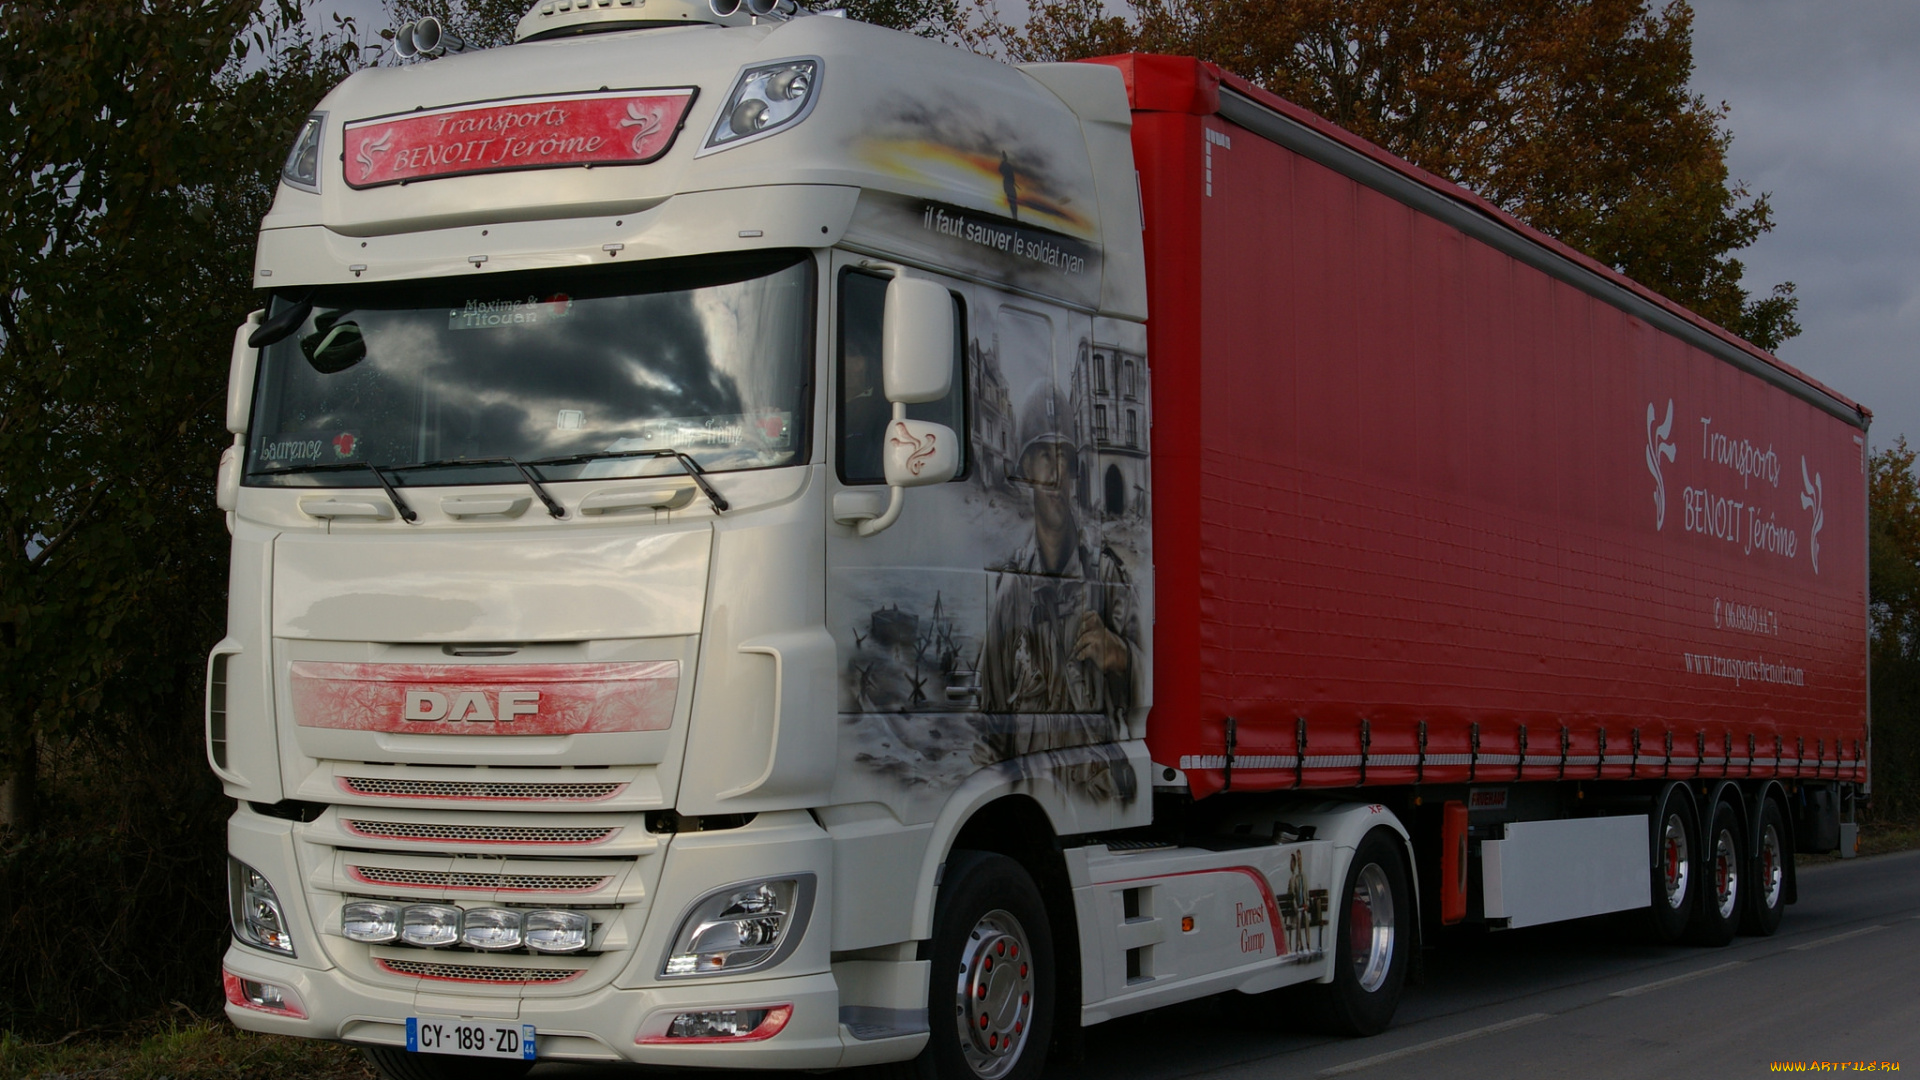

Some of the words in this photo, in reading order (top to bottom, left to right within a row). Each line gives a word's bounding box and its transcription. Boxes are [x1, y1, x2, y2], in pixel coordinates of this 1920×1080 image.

[437, 105, 570, 136] Transports
[392, 139, 492, 172] BENOIT
[491, 134, 604, 164] Jérôme
[923, 205, 933, 230] il
[936, 208, 965, 239] faut
[965, 222, 1012, 252] sauver
[1012, 231, 1025, 255] le
[1026, 240, 1060, 267] soldat
[1060, 252, 1085, 276] ryan
[463, 312, 537, 326] Titouan
[464, 299, 524, 315] Maxime
[259, 436, 323, 461] Laurence
[1700, 416, 1780, 490] Transports
[1683, 486, 1743, 543] BENOIT
[1744, 507, 1798, 558] Jérôme
[1683, 652, 1805, 687] www.transports-benoit.com
[405, 690, 541, 721] DAF
[1367, 804, 1383, 815] XF
[1235, 901, 1265, 928] Forrest
[1240, 928, 1265, 955] Gump
[524, 1043, 535, 1055] 44
